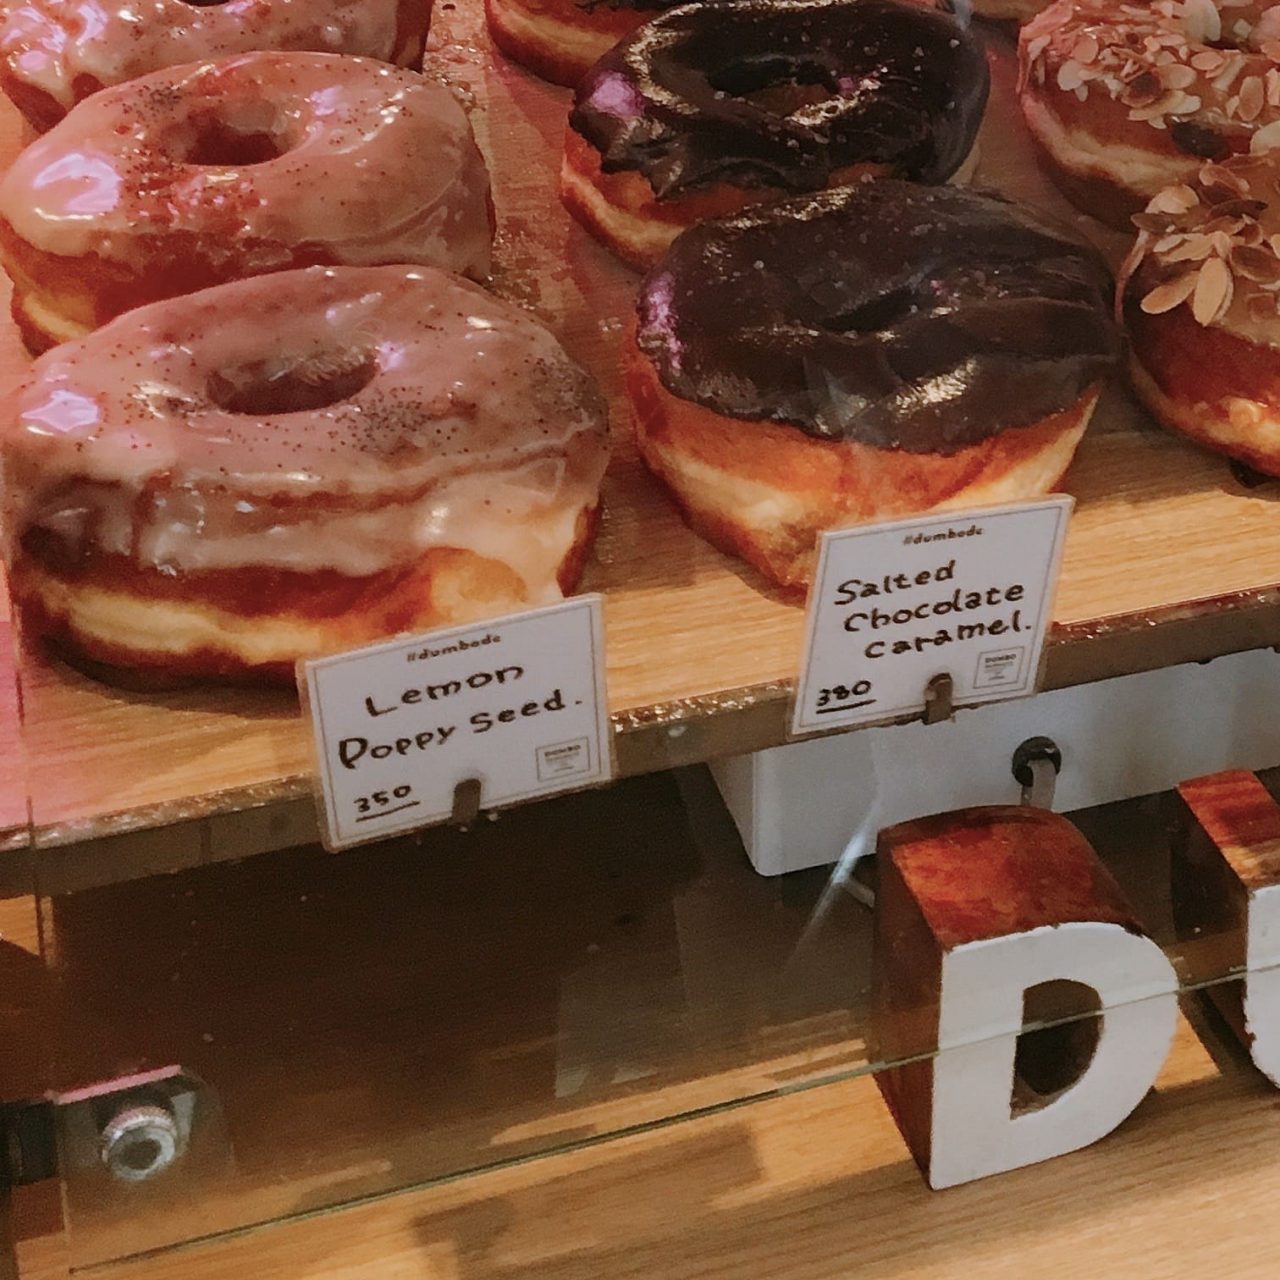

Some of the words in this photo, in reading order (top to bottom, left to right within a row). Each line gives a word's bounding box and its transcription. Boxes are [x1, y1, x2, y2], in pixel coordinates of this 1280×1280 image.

[903, 525, 983, 546] #dumbodc
[834, 560, 956, 606] Salted
[407, 634, 502, 663] #dumbodc
[365, 666, 525, 718] Lemon
[816, 680, 872, 707] 380
[338, 725, 456, 770] Poppy
[469, 689, 583, 734] Seed.
[353, 785, 411, 814] 350
